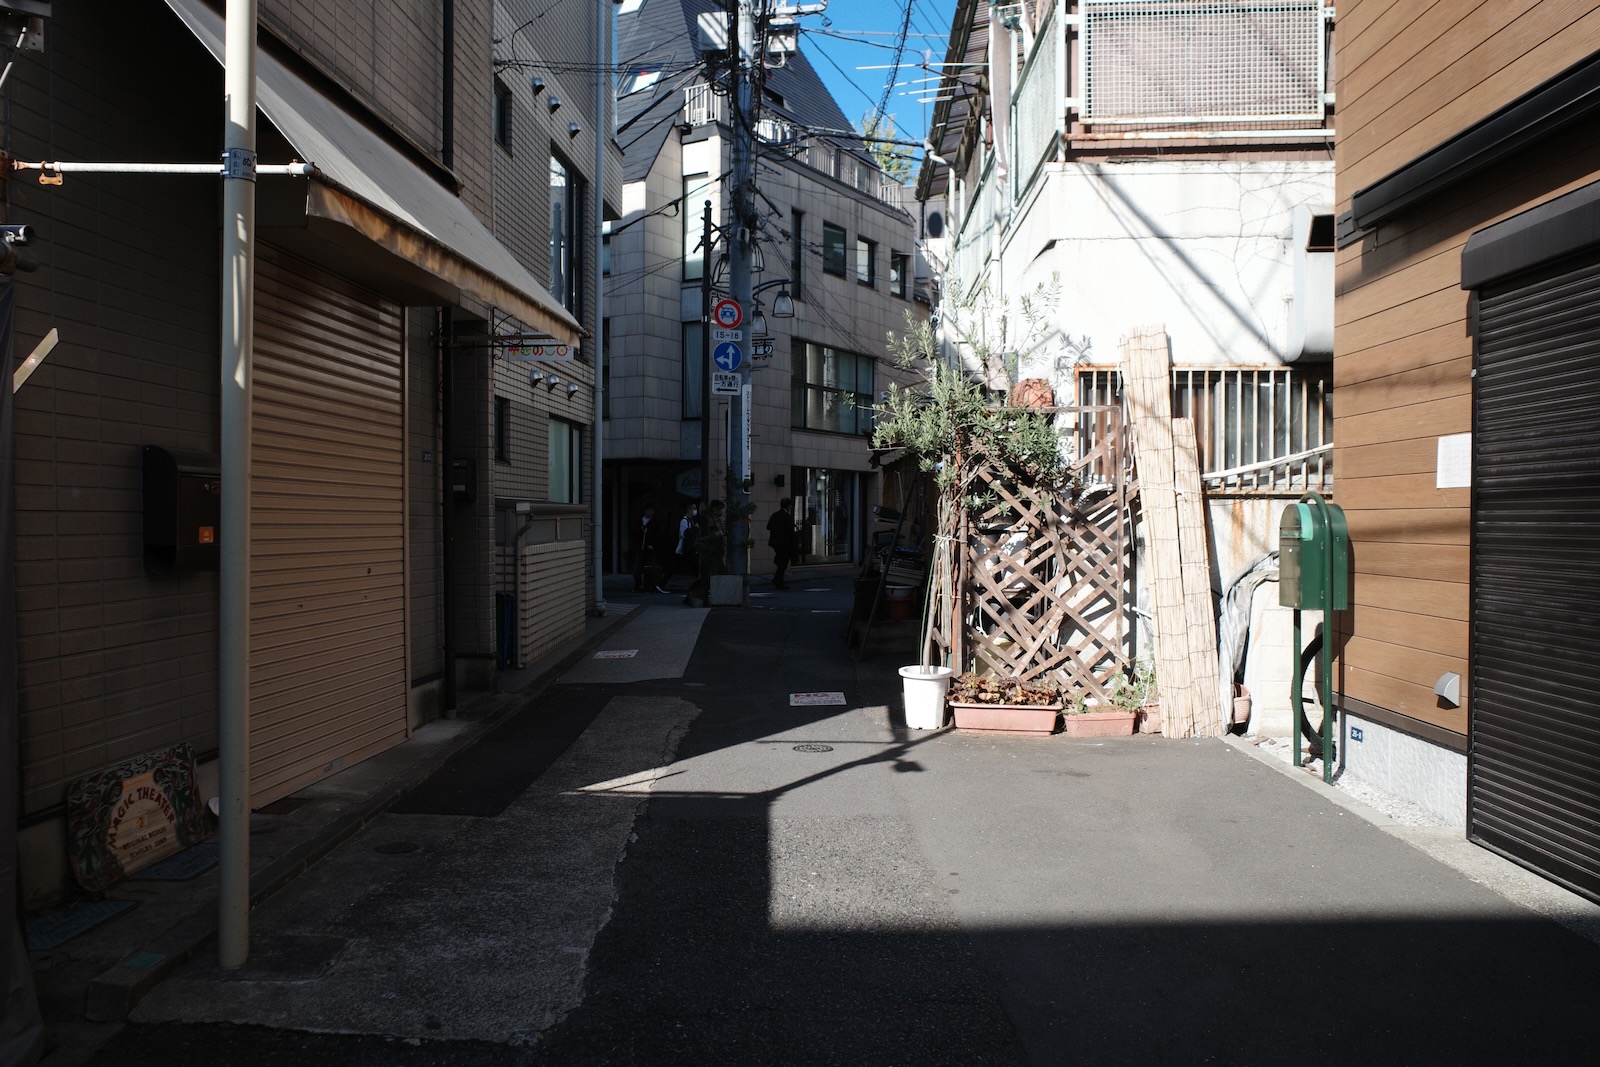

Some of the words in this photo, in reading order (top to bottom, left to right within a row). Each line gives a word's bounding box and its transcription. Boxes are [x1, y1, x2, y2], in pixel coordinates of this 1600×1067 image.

[716, 331, 739, 339] 15-18
[108, 793, 135, 849] MAGIC
[136, 786, 175, 824] THEATER
